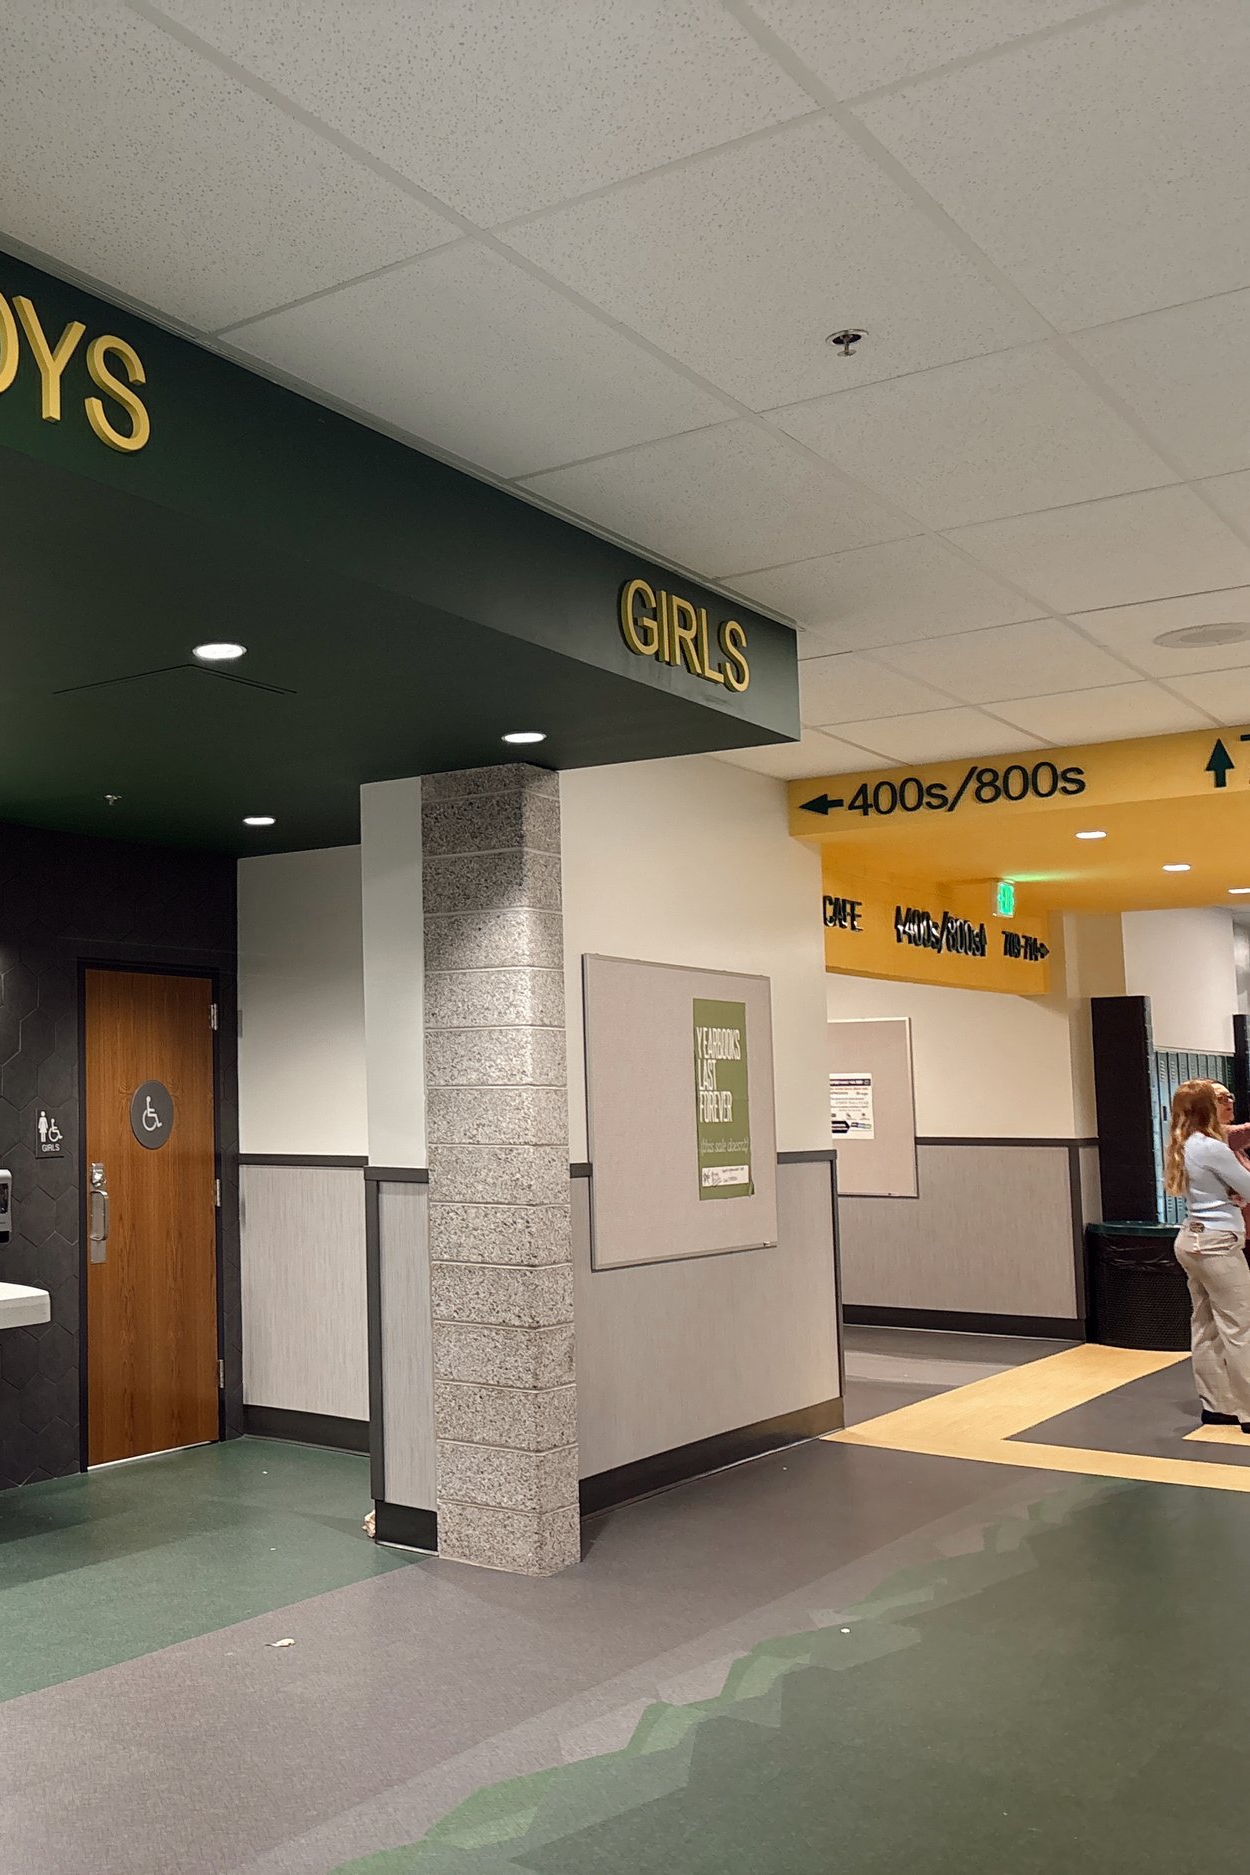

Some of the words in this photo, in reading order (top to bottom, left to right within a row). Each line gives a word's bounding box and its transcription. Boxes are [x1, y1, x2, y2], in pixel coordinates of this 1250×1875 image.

[620, 578, 750, 692] GIRLS
[847, 761, 1086, 817] 400s/800s
[823, 895, 864, 932] CAFE
[696, 1026, 741, 1060] YEARBOOKS
[698, 1059, 717, 1091] LAST
[699, 1091, 733, 1123] FOREVER
[41, 1143, 60, 1152] GIRLS
